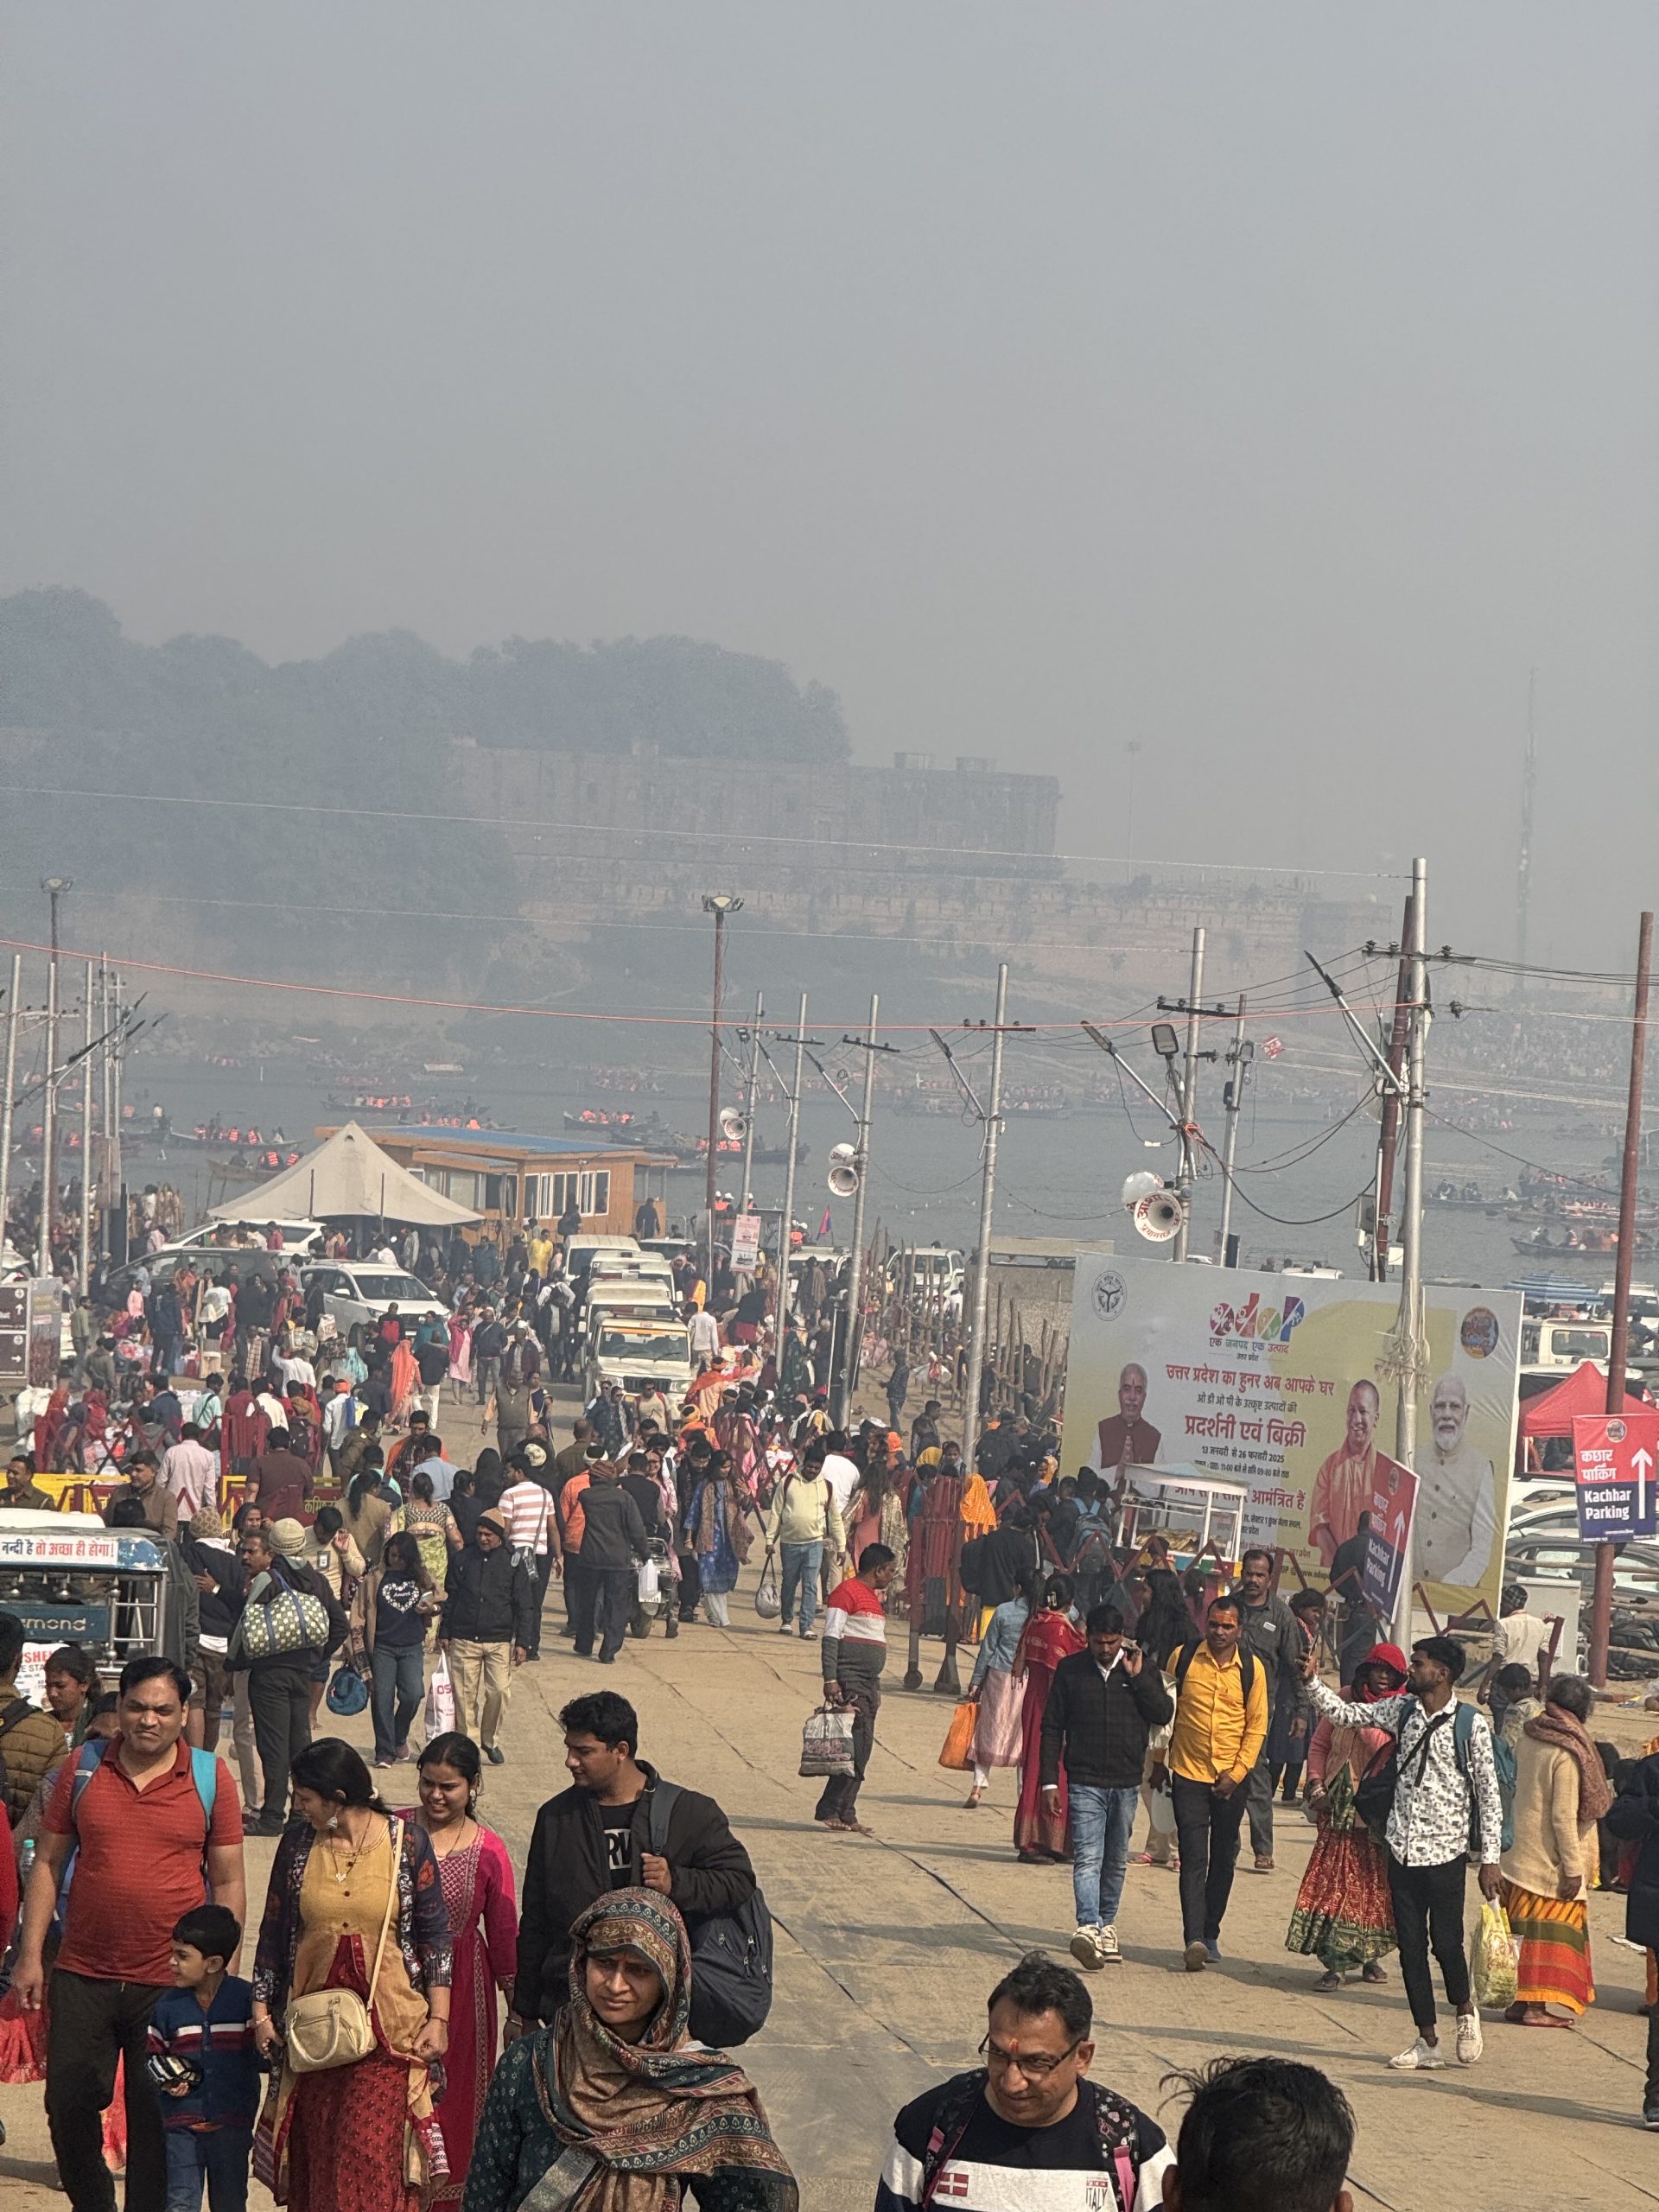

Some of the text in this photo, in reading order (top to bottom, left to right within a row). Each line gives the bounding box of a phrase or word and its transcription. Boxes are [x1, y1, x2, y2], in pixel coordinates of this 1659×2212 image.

[1210, 1338, 1290, 1354] एक जनपद एक उत्पाद
[1166, 1363, 1335, 1395] उत्तर प्रदेश का हुनर अब आपके घर
[1226, 1396, 1234, 1408] पी
[1235, 1397, 1243, 1408] के
[1287, 1402, 1298, 1414] की
[1185, 1412, 1306, 1447] प्रदर्शनी एवं बिक्री
[1201, 1446, 1285, 1463] 13 जनवरी से 26 फरवरी 2025
[1580, 1450, 1613, 1462] कछार
[1252, 1487, 1294, 1509] आमंत्रित
[1297, 1490, 1306, 1510] हैं
[1585, 1489, 1631, 1503] Kachhar
[1586, 1506, 1630, 1521] Parking
[2, 1539, 22, 1554] नन्दी
[25, 1539, 34, 1555] है
[36, 1540, 46, 1555] तो
[48, 1541, 73, 1555] अच्छा
[76, 1540, 86, 1556] ही
